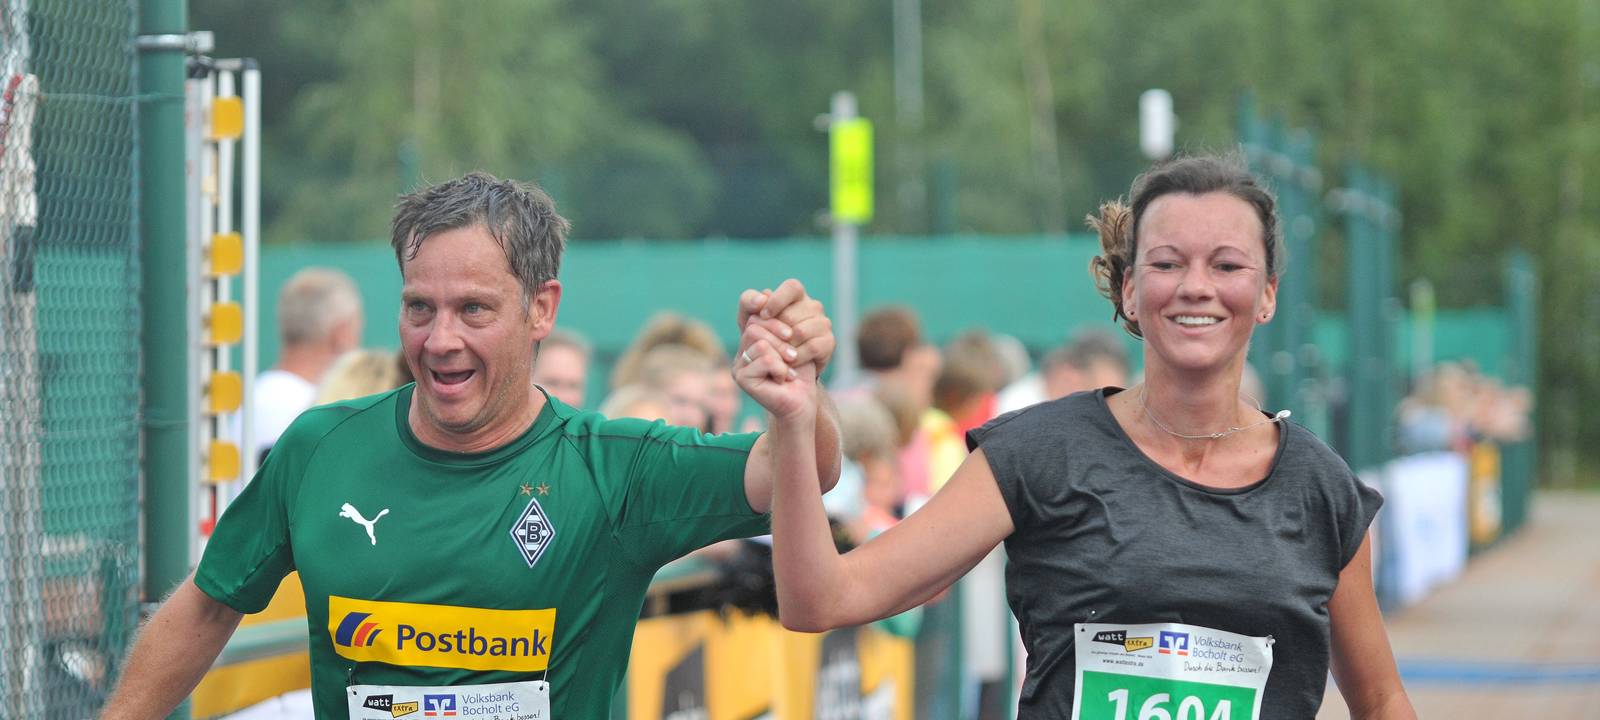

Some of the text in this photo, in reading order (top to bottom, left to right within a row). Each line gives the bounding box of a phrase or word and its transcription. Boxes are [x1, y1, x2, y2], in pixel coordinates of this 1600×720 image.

[525, 520, 543, 546] B
[396, 623, 548, 657] Postbank
[1097, 632, 1124, 641] watt
[1194, 635, 1243, 652] Volksbank
[1192, 647, 1245, 663] Bocholt eG
[367, 698, 390, 707] watt
[461, 691, 515, 704] Volksbank
[462, 702, 520, 716] Bocholt eG
